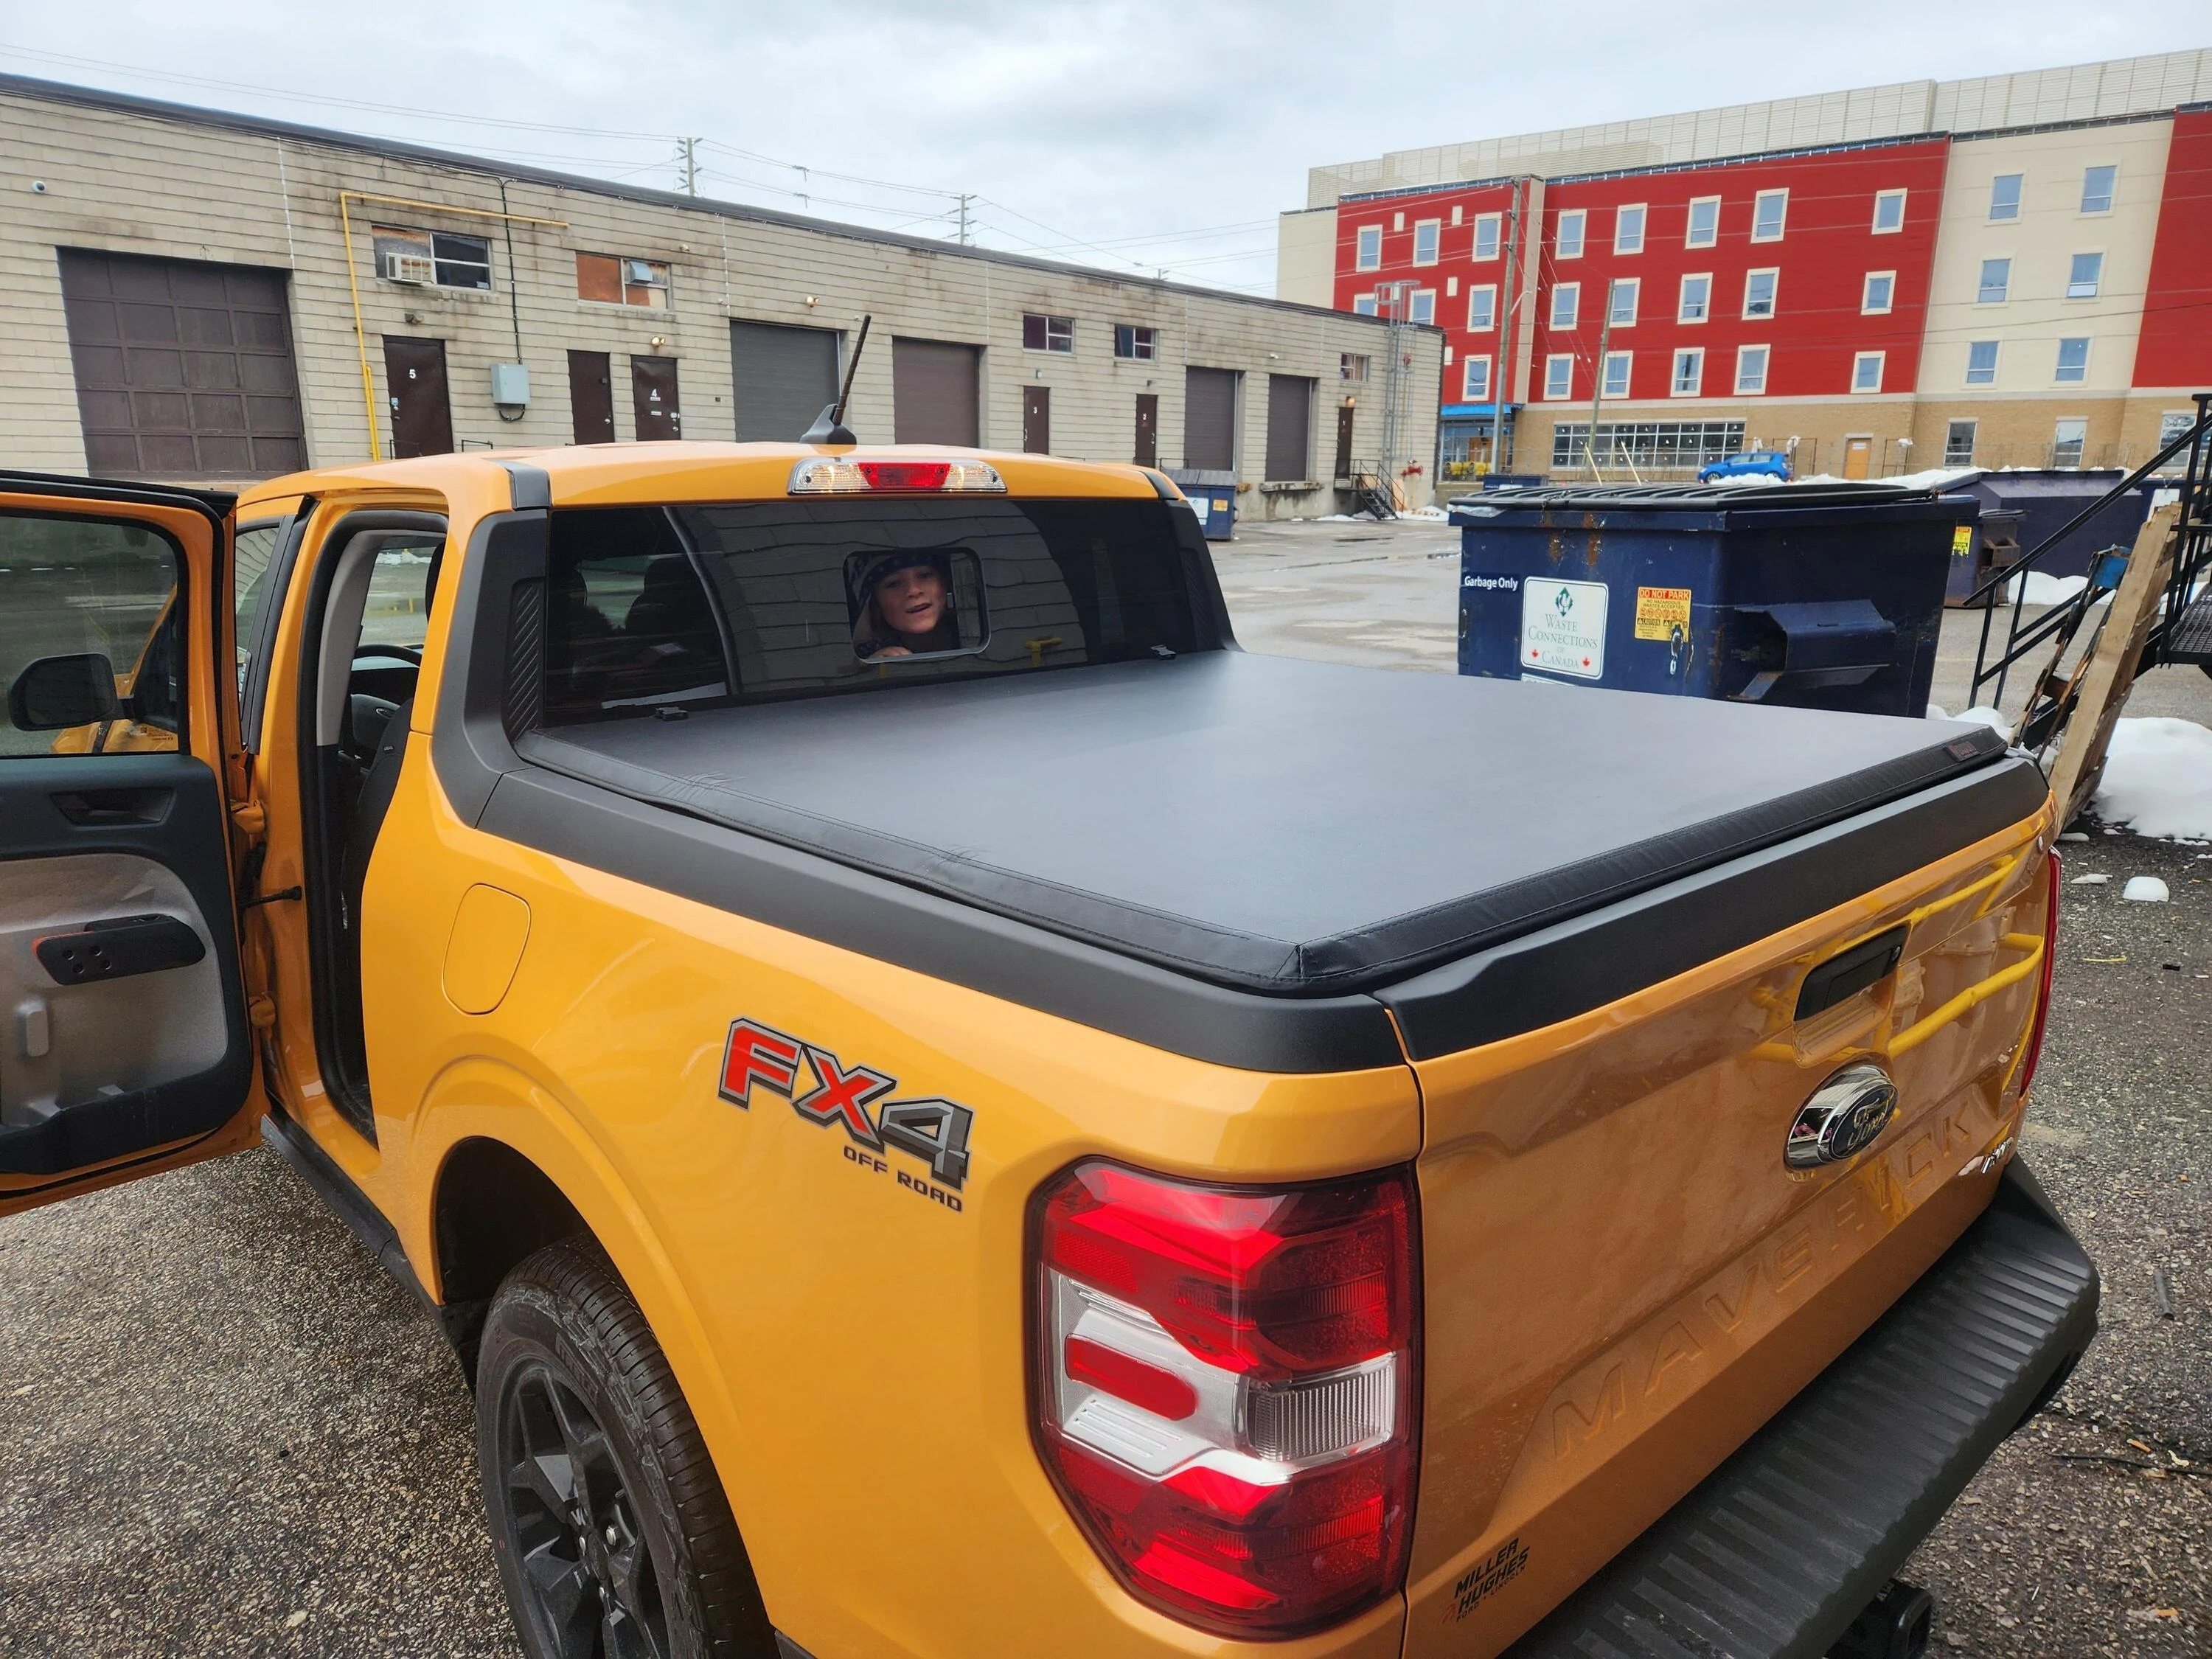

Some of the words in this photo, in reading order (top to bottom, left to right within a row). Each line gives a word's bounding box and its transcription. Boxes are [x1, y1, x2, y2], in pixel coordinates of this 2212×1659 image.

[409, 369, 417, 379] 5
[651, 388, 658, 397] 4
[1033, 406, 1038, 414] 3
[1464, 575, 1497, 591] Garbage
[1498, 577, 1518, 591] Only
[1639, 589, 1650, 597] DO
[1652, 590, 1666, 599] NOT
[1669, 591, 1689, 599] PARK
[1545, 613, 1578, 632] WASTE
[1528, 625, 1598, 650] CONNECTIONS
[1542, 651, 1579, 669] CANADA
[718, 1017, 975, 1192] FX4
[1847, 1096, 1891, 1152] Ford
[844, 1145, 888, 1174] OFF
[897, 1169, 962, 1211] ROAD
[1553, 1100, 1972, 1461] MAVERICK
[1454, 1537, 1519, 1599] MILLER
[1458, 1545, 1531, 1615] HUGHES
[1456, 1601, 1480, 1624] FORD
